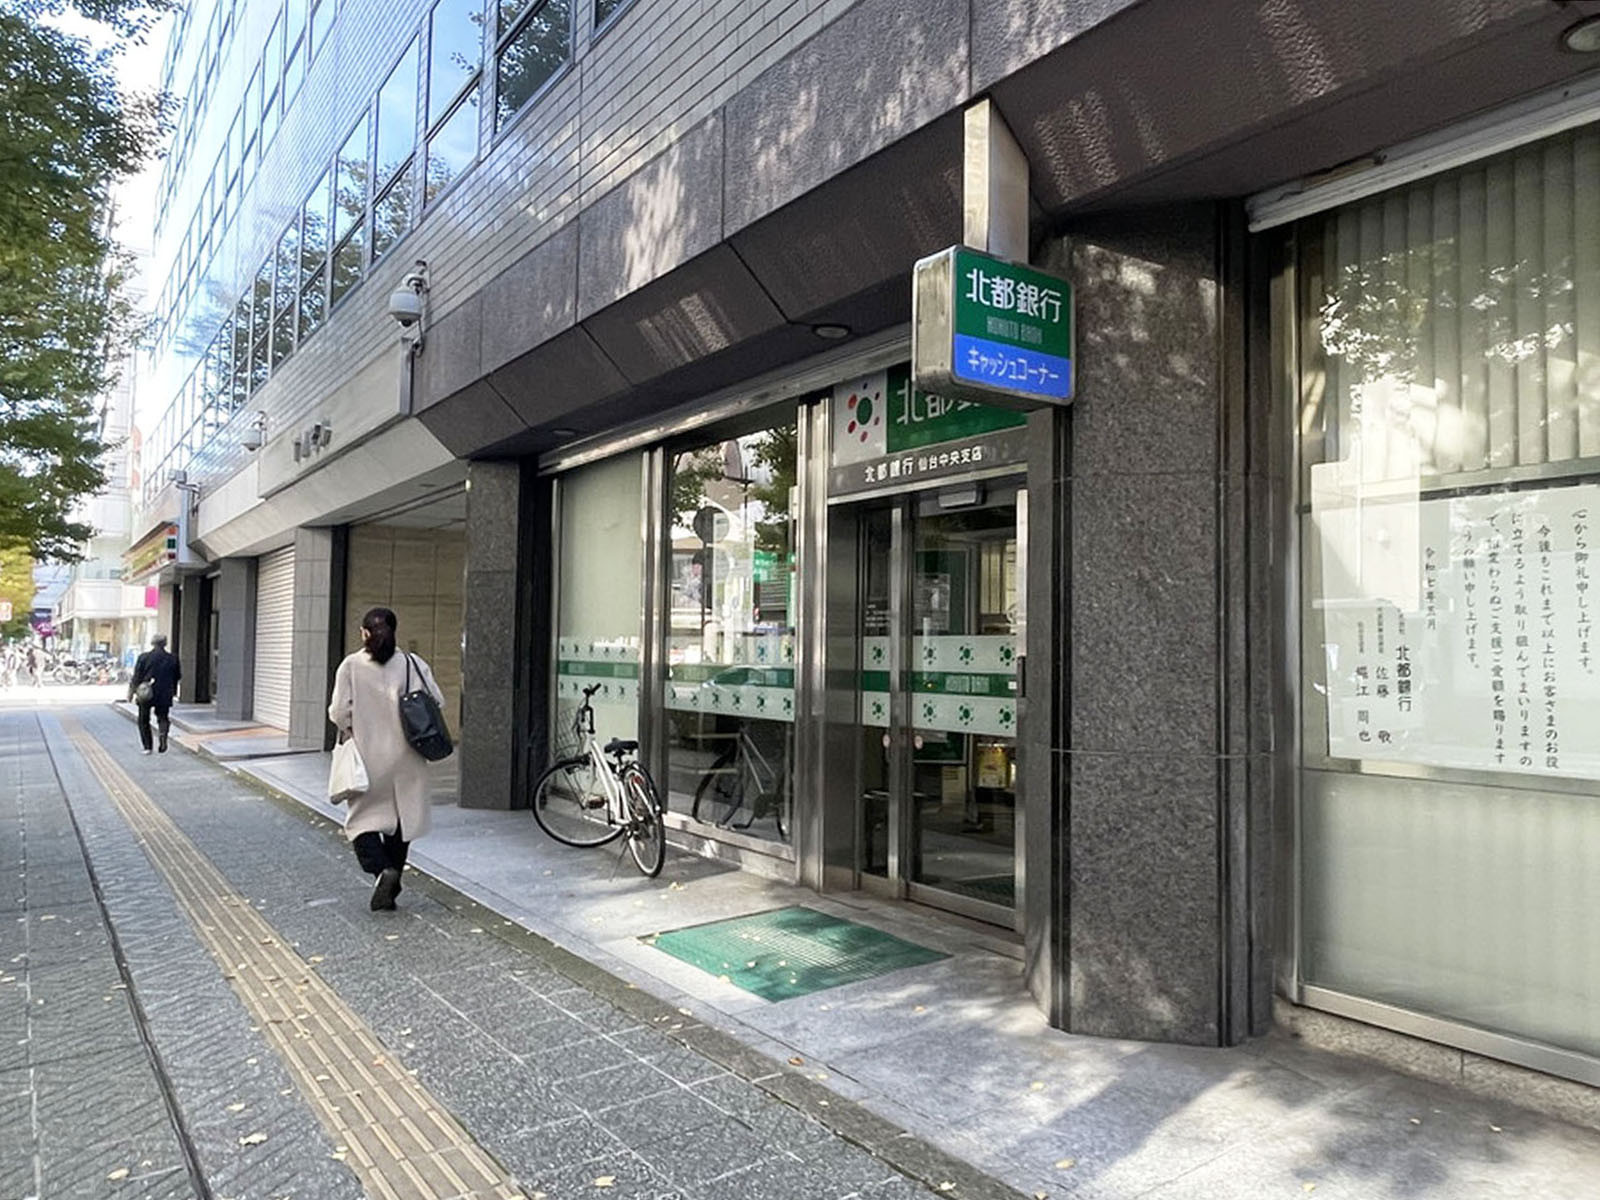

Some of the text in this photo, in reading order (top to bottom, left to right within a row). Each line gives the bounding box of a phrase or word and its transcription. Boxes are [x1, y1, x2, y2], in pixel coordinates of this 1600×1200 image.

[966, 268, 1061, 323] 北都銀行
[968, 346, 1059, 385] キャッシュコーナー
[865, 446, 982, 482] 北都銀行 仙台中央支店
[1395, 644, 1412, 712] 北都銀行
